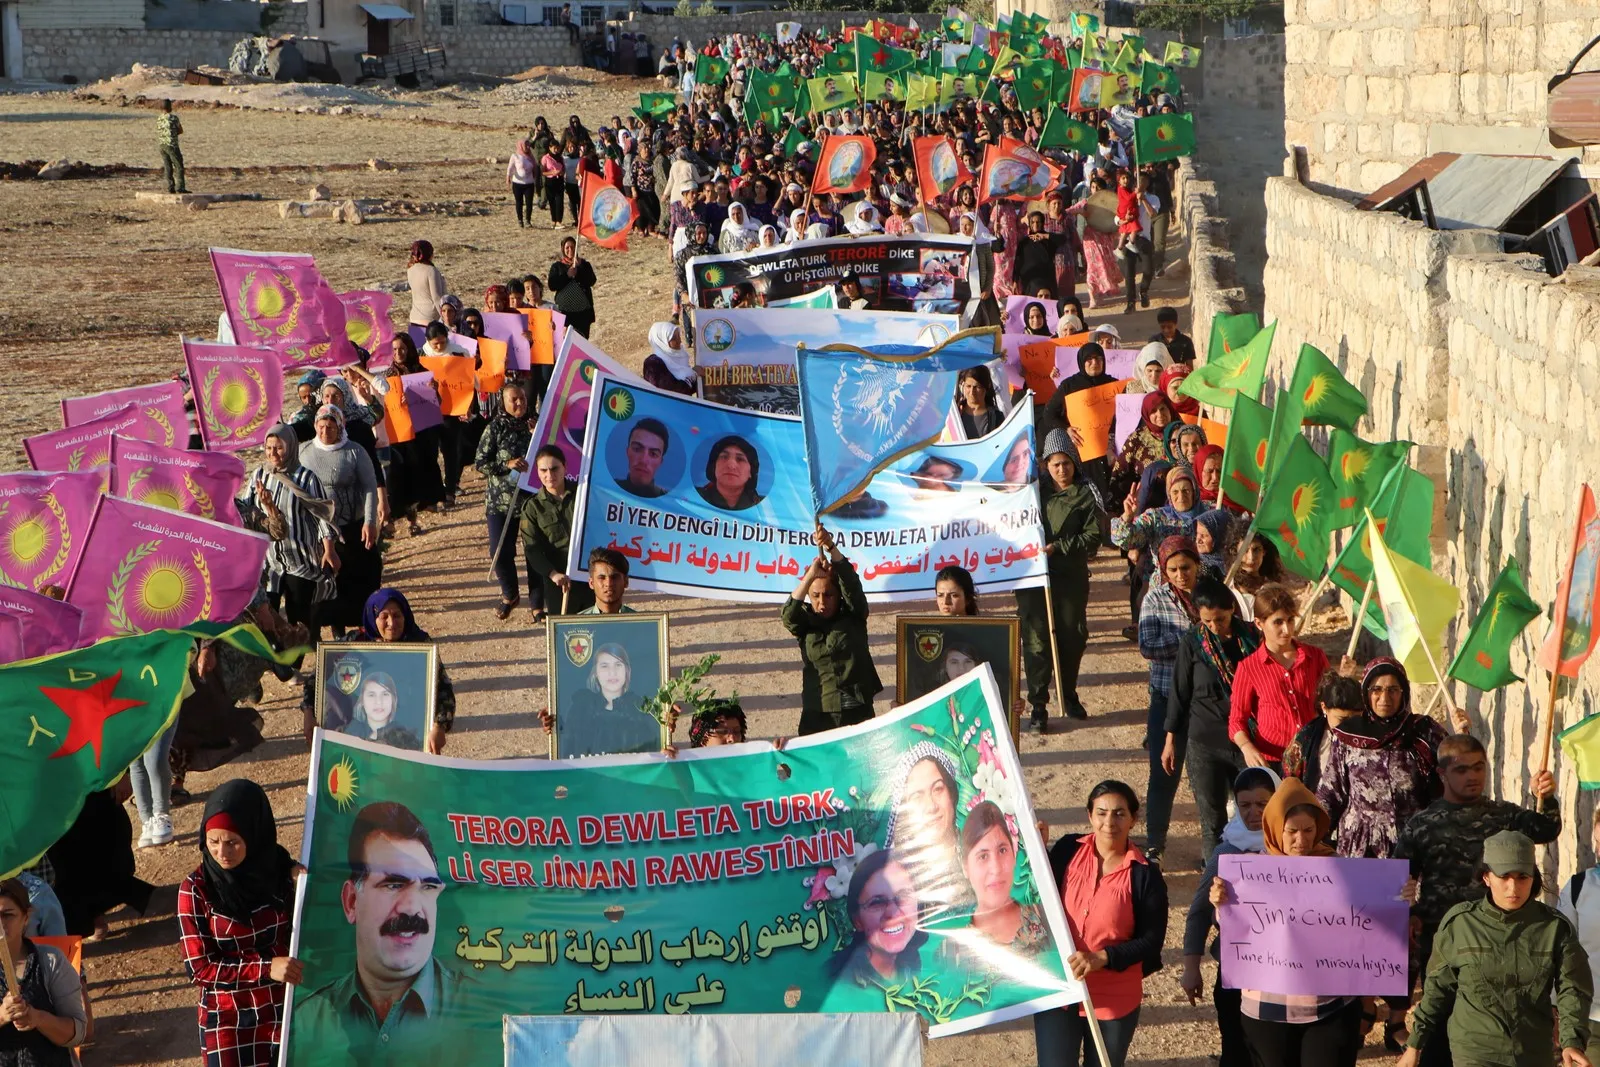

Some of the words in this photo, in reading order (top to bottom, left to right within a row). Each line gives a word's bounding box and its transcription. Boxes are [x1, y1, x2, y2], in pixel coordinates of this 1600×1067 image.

[749, 258, 799, 274] DEWLETA
[800, 254, 826, 266] TURK
[829, 246, 886, 261] TERORÊ
[132, 520, 165, 534] للشهباء
[165, 527, 184, 540] الحرة
[184, 532, 203, 544] المرأة
[628, 507, 660, 529] YEK
[664, 514, 719, 537] DENGÎ
[851, 528, 926, 548] DEWLETA
[931, 519, 971, 541] TURK
[202, 540, 226, 552] مجلس
[686, 544, 751, 575] الدولة
[3, 601, 34, 614] مجلس
[447, 812, 572, 846] TERORA
[577, 804, 740, 846] DEWLETA
[743, 787, 836, 831] TURK
[479, 859, 537, 888] SER
[660, 920, 750, 968] إرهاب
[754, 900, 829, 959] أوقفو
[455, 925, 558, 971] التركية
[564, 929, 653, 972] الدولة
[564, 977, 656, 1013] النساء
